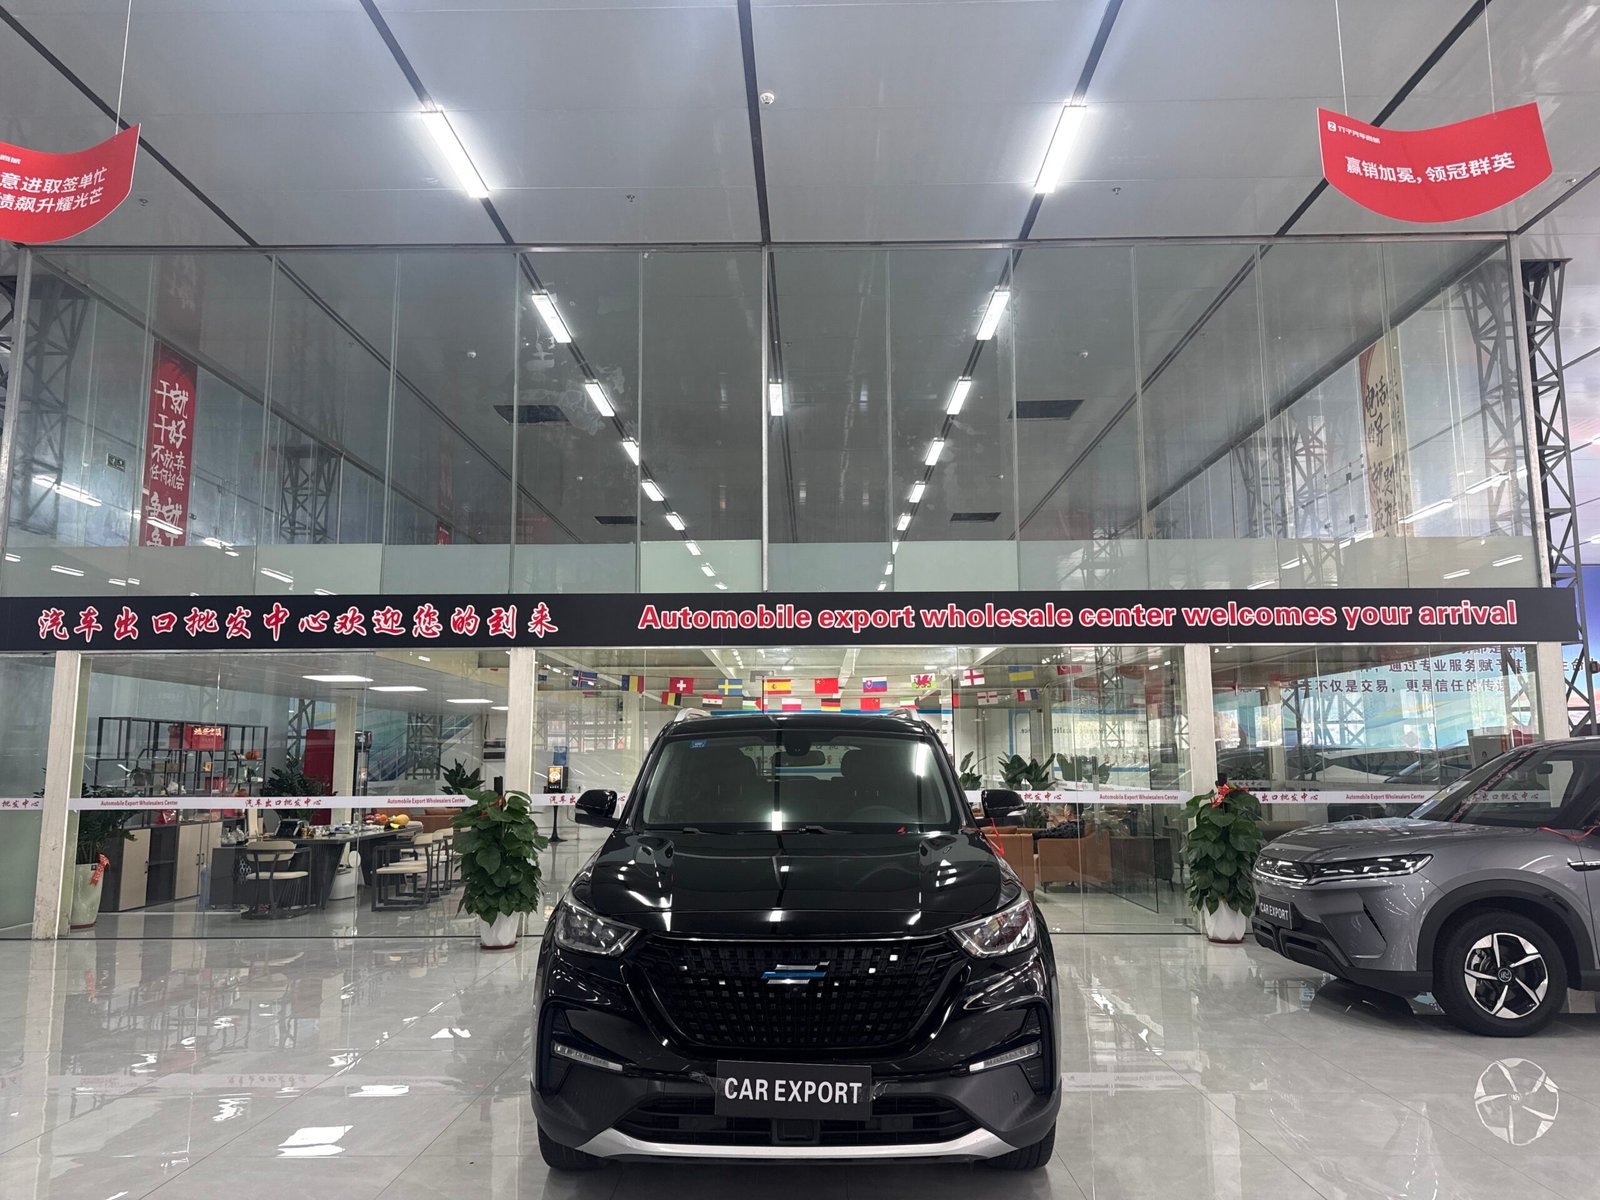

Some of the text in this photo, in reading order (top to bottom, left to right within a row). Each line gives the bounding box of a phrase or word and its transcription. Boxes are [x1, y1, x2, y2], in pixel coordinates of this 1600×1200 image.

[38, 602, 559, 642] 汽车出口批发中心欢迎您的到来
[638, 600, 1517, 633] Automobile export wholesale center welcomes your arrival
[245, 798, 322, 807] 汽车出口批发中心
[724, 1077, 862, 1104] CAR EXPORT
